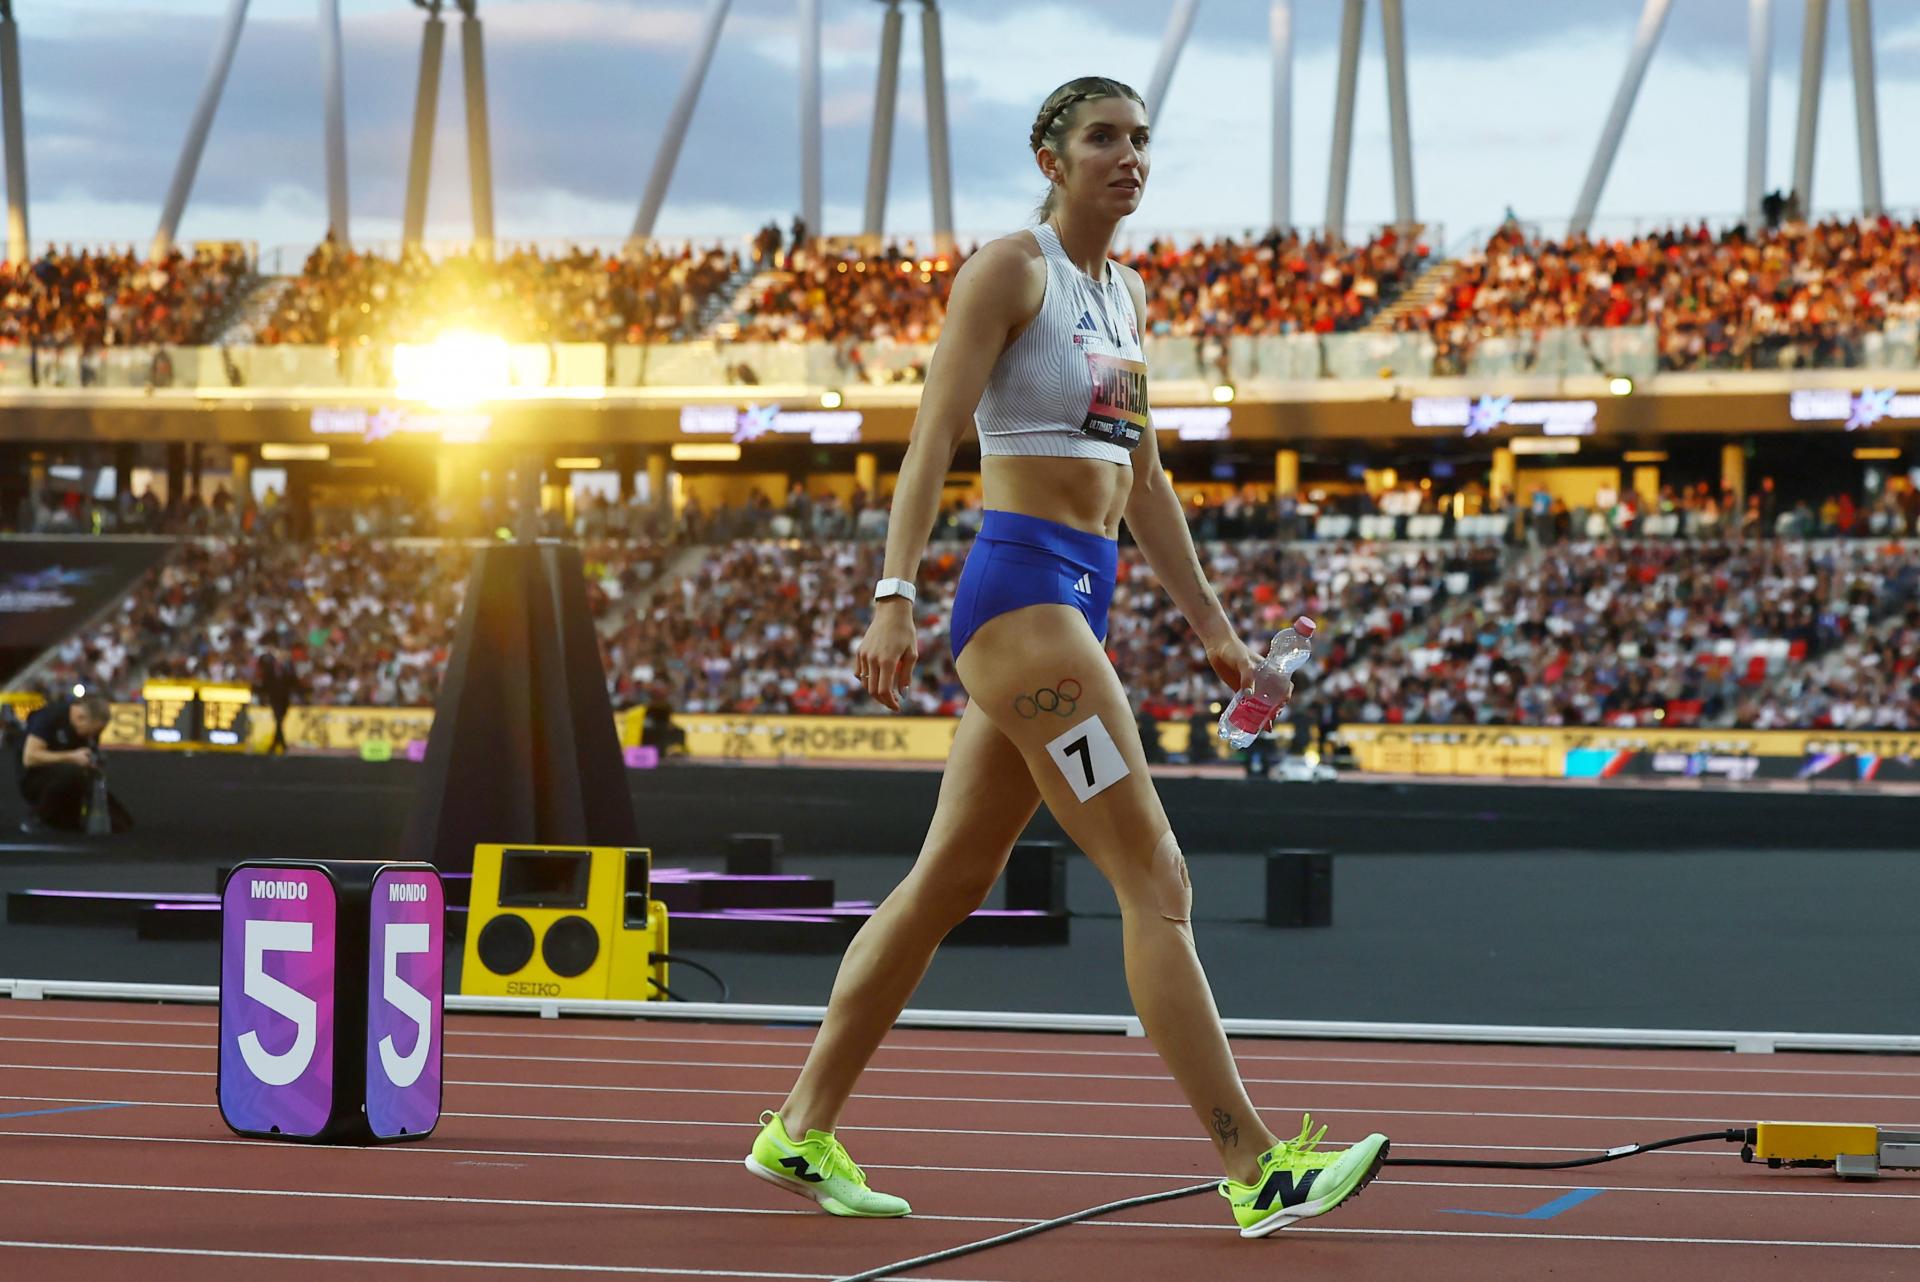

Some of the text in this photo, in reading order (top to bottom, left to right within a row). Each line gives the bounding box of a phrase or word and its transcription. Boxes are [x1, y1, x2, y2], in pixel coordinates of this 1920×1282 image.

[770, 727, 909, 750] PROSPEX
[1063, 735, 1095, 787] 7
[251, 880, 308, 900] MONDO
[389, 884, 427, 901] MONDO
[506, 982, 561, 997] SEIKO
[238, 920, 317, 1086] 5
[378, 923, 432, 1088] 5
